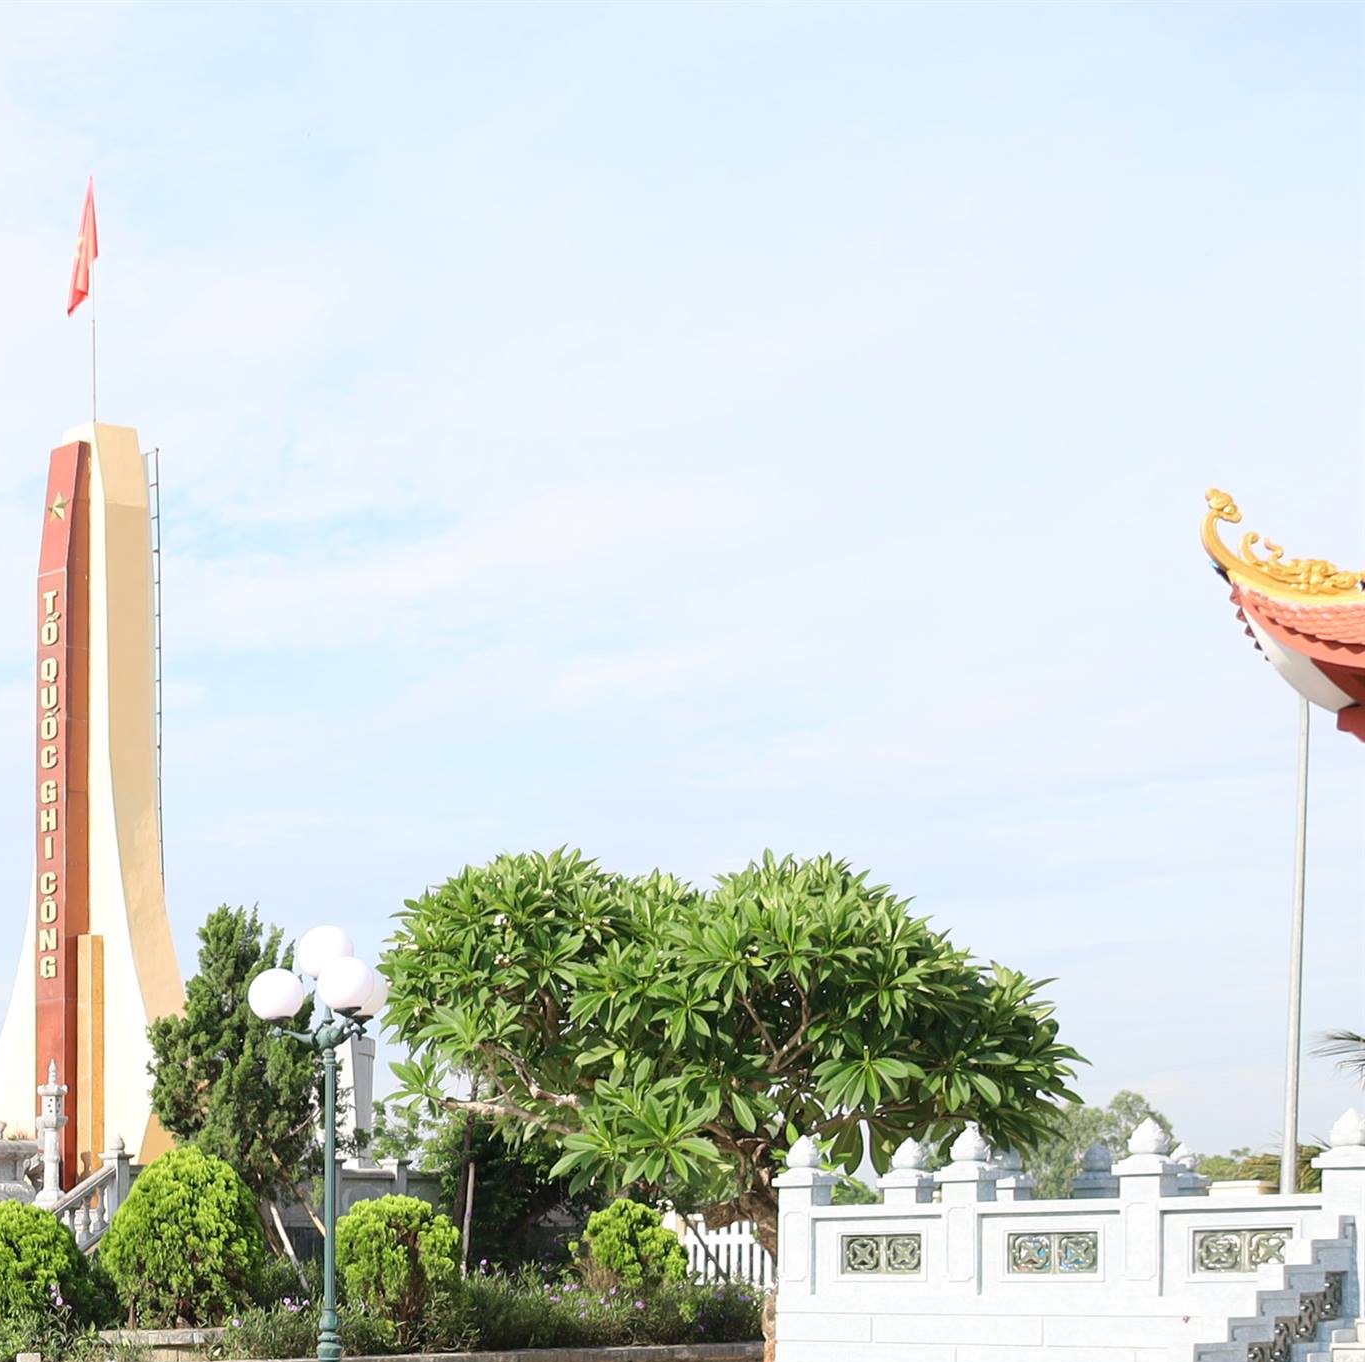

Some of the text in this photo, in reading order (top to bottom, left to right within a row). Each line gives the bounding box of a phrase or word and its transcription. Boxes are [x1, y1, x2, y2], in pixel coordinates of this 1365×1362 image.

[39, 590, 61, 979] TỔ QUỐC GHI CÔNG
